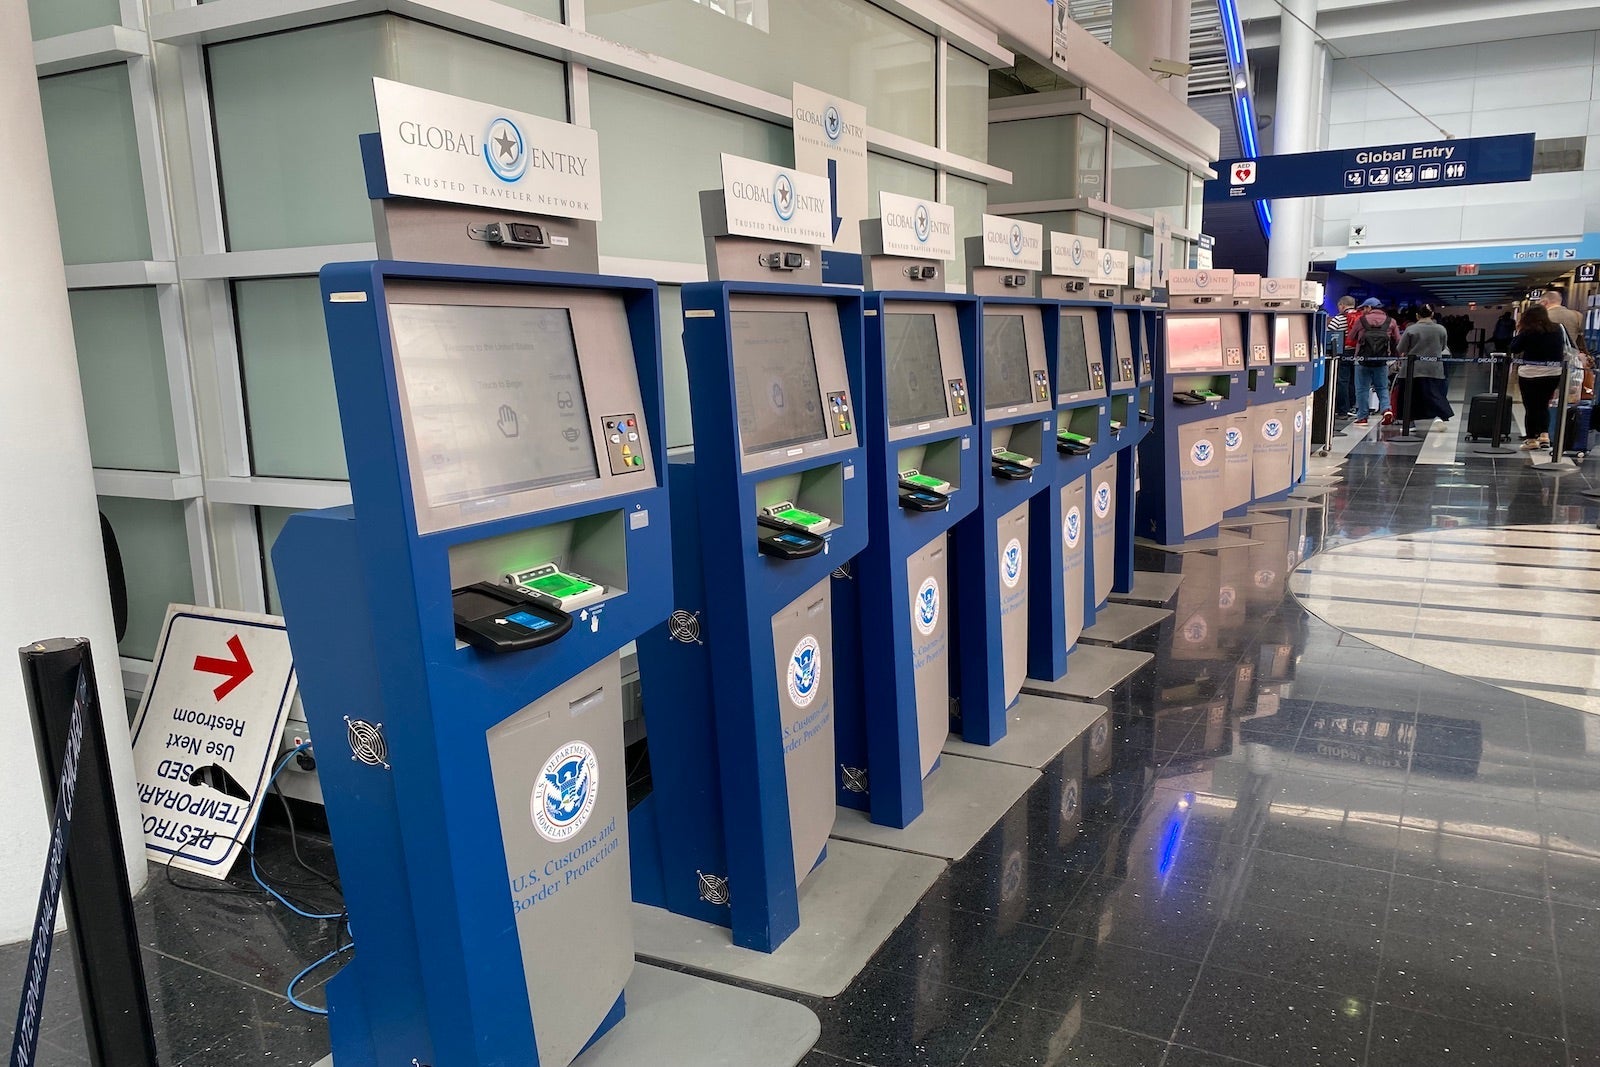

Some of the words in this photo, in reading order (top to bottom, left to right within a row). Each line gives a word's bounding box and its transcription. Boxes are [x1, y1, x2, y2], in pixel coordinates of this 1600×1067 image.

[795, 108, 824, 124] GLOBAL
[841, 124, 864, 139] ENTRY
[399, 121, 480, 157] GLOBAL
[532, 148, 588, 176] ENTRY
[1356, 149, 1407, 164] Global
[1412, 146, 1454, 159] Entry
[403, 173, 466, 192] TRUSTED
[473, 184, 532, 201] TRAVELER
[538, 194, 590, 210] NETWORK
[732, 181, 772, 204] GLOBAL
[796, 194, 825, 213] ENTRY
[886, 212, 914, 230] GLOBAL
[930, 220, 951, 234] ENTRY
[987, 231, 1009, 244] GLOBAL
[1022, 236, 1039, 249] ENTRY
[1513, 251, 1543, 259] Toilets
[172, 708, 246, 737] Restroom
[61, 699, 83, 822] CHICAGO
[165, 733, 203, 755] Next
[205, 741, 235, 762] Use
[535, 781, 546, 799] U.S.
[546, 745, 591, 773] DEPARTMENT
[588, 758, 596, 770] OF
[137, 782, 240, 825] TEMPORARI
[536, 810, 574, 838] HOMELAND
[575, 780, 597, 830] SECURITY
[141, 813, 217, 850] RESTRO
[513, 873, 540, 893] U.S.
[544, 840, 597, 877] Customs
[599, 816, 616, 842] and
[512, 880, 561, 915] Border
[565, 837, 619, 886] Protection
